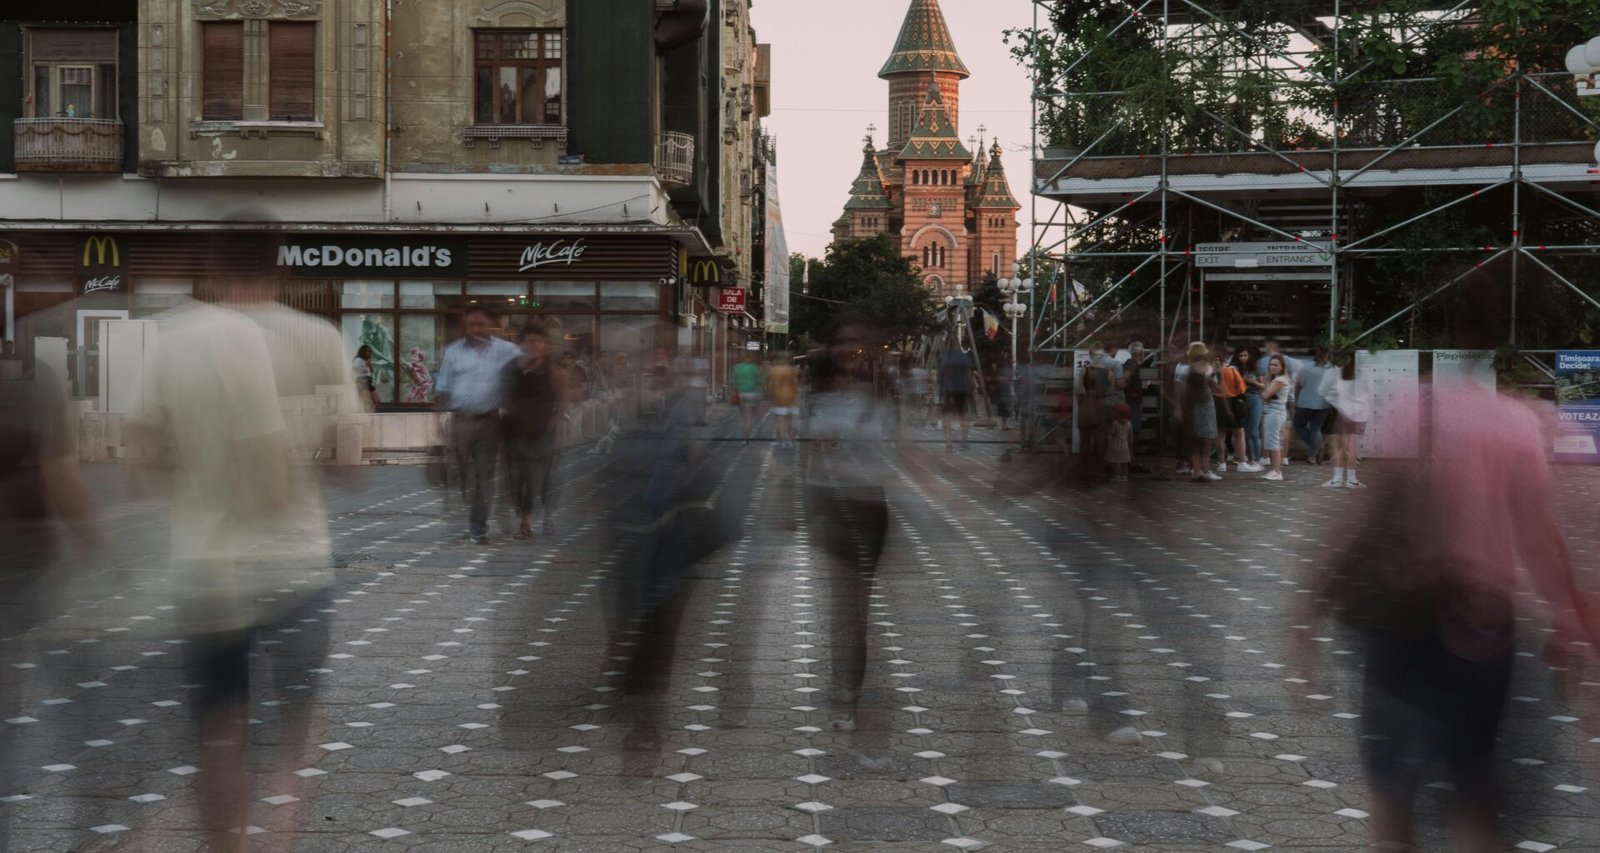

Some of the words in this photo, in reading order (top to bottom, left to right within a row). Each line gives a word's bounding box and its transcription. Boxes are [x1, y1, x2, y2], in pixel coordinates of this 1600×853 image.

[276, 245, 452, 267] McDonald's
[519, 237, 588, 270] McCafé
[1198, 256, 1219, 264] EXIT
[1266, 255, 1315, 263] ENTRANCE
[722, 288, 742, 296] SALA
[1559, 361, 1591, 369] Decide!
[1558, 412, 1600, 421] VOTEAZ
